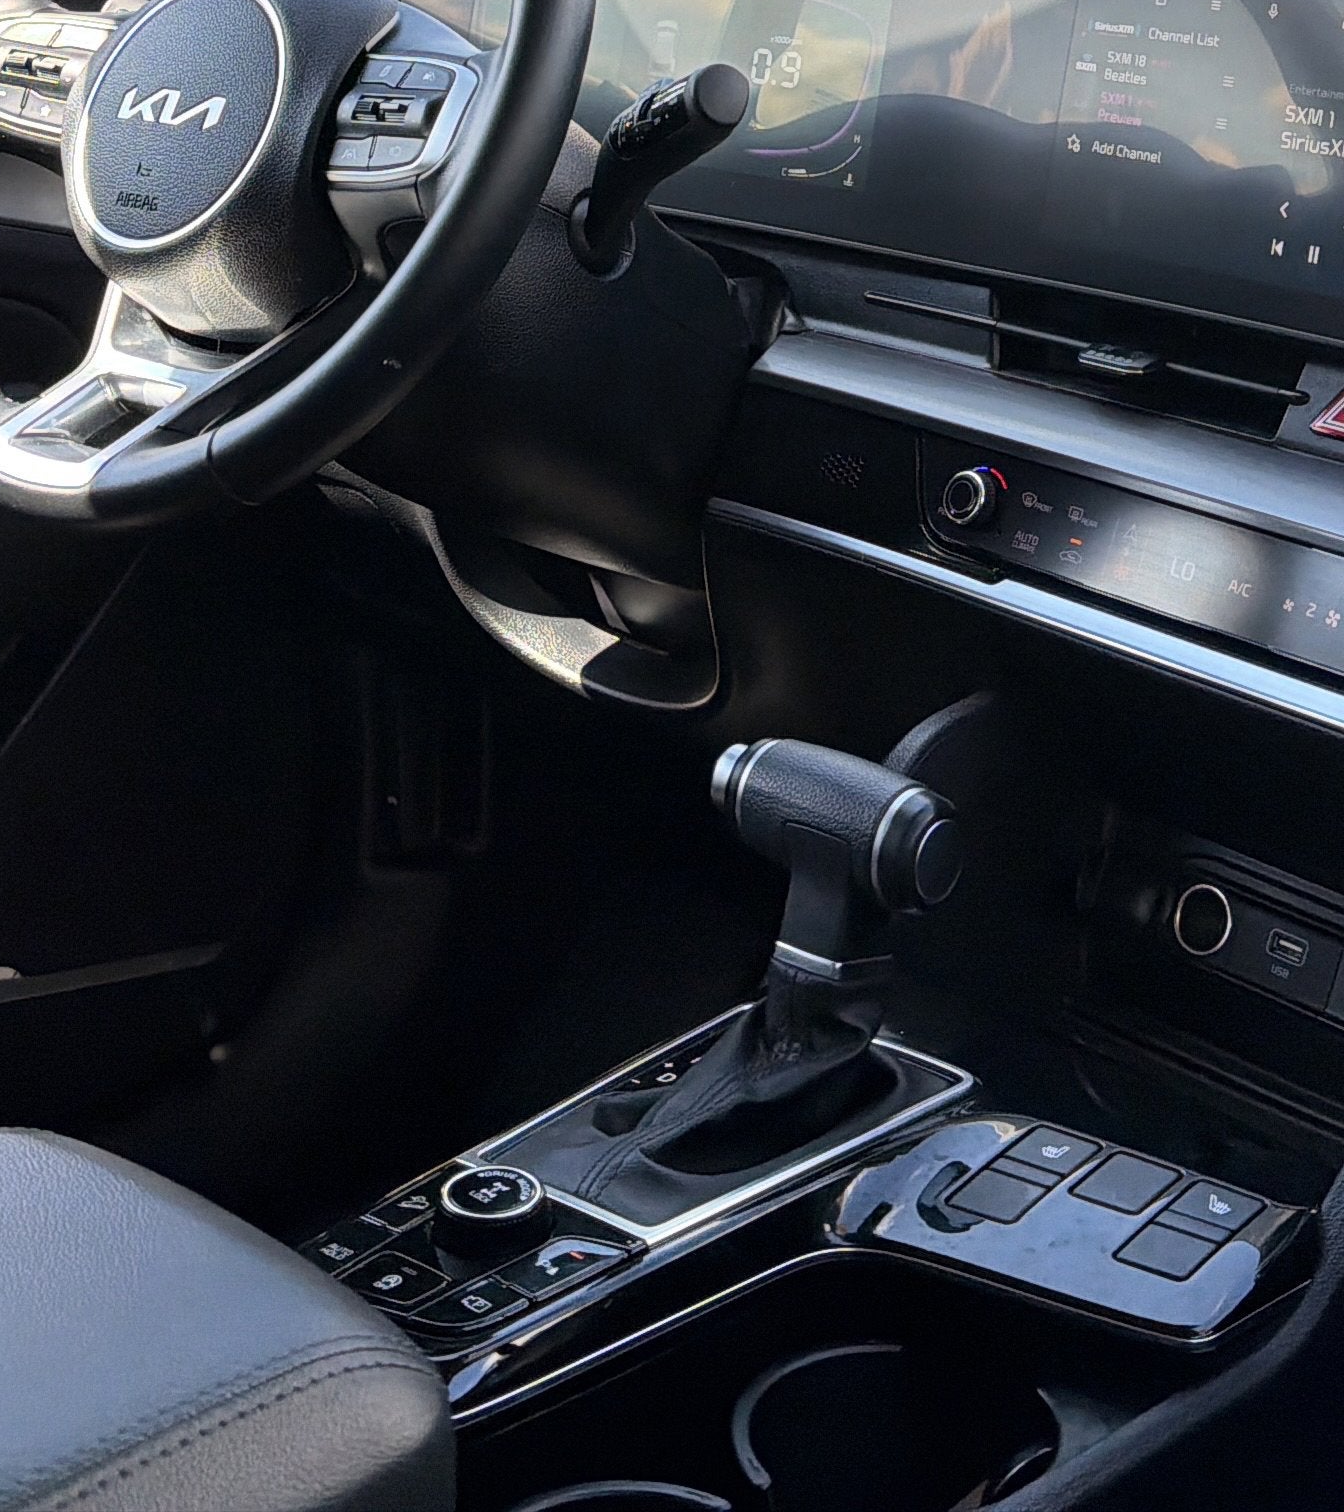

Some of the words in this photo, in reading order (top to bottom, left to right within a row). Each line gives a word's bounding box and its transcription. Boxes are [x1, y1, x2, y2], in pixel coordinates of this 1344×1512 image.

[1148, 26, 1195, 45] Channel
[1196, 31, 1220, 48] List
[1107, 50, 1132, 65] SXM
[1134, 54, 1147, 68] 18
[750, 48, 802, 89] 0.9
[1103, 67, 1147, 86] Beatles
[116, 84, 227, 130] KIA
[1099, 91, 1125, 106] SXM
[1097, 107, 1143, 127] Preview
[1284, 104, 1326, 127] SXM
[1328, 110, 1336, 129] 1
[1091, 140, 1114, 156] Add
[1115, 144, 1162, 164] Channel
[114, 188, 159, 213] AIRBAG
[1081, 516, 1099, 529] REAR
[1014, 530, 1040, 547] AUTO
[1170, 558, 1196, 582] LO
[1227, 579, 1252, 598] A/C
[1305, 602, 1317, 619] 2
[1270, 963, 1291, 980] USB
[656, 1072, 677, 1083] D
[484, 1170, 518, 1181] DRIVE
[319, 1246, 346, 1262] HOLD
[327, 1242, 355, 1258] AUTO
